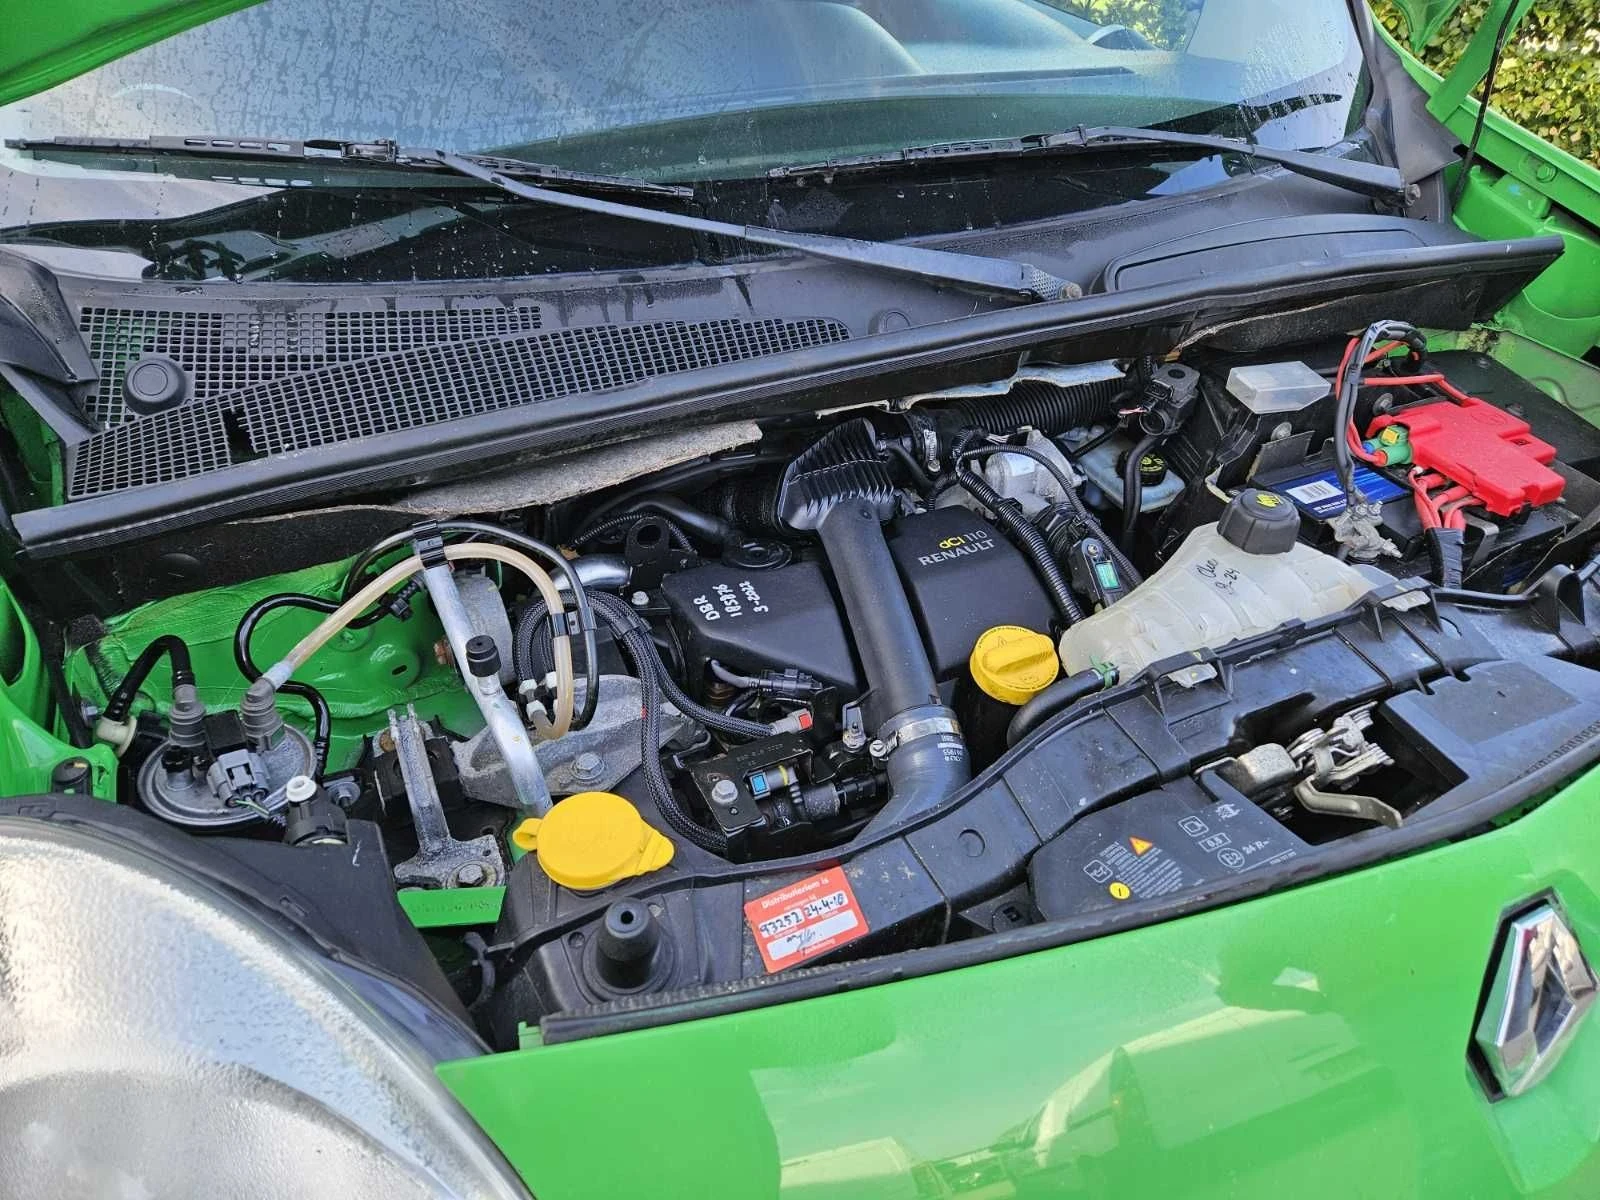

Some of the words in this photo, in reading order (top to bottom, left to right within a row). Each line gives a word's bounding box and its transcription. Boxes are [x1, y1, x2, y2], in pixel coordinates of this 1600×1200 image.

[963, 530, 988, 542] 110
[918, 539, 995, 566] RENAULT
[693, 594, 721, 621] DBR
[712, 583, 743, 617] 185876
[739, 580, 769, 613] 3-2022
[820, 877, 830, 885] is
[760, 911, 803, 935] 93252
